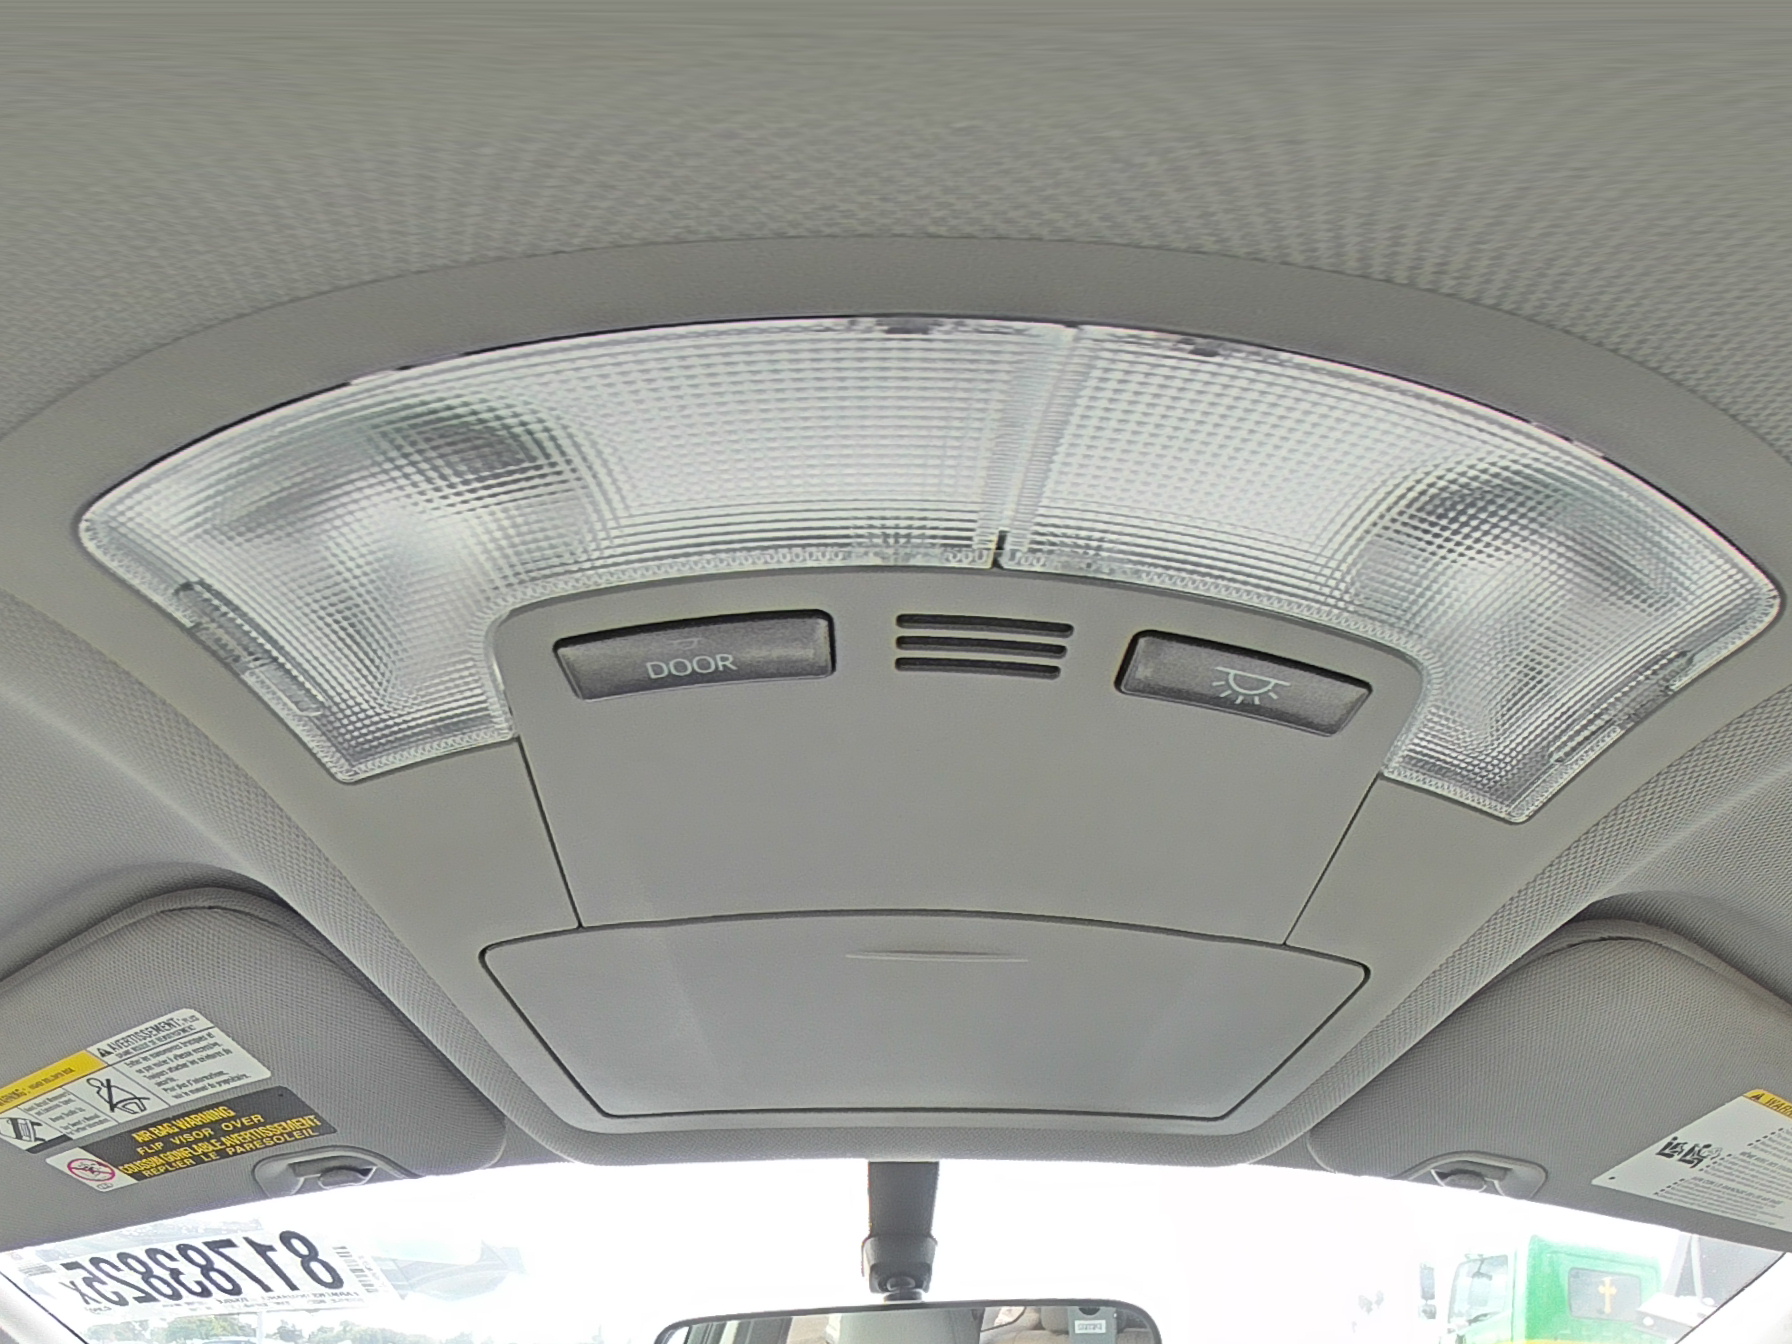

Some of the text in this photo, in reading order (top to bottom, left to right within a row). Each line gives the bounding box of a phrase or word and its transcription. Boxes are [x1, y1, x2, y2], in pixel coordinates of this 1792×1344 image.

[645, 652, 739, 680] DOOR
[117, 1114, 322, 1174] COUSSIN GONFLABLE AVERTISSEMENT
[131, 1105, 236, 1143] AIR BAG WARNING
[136, 1113, 265, 1156] FLIP VISOR OVER
[141, 1128, 320, 1178] REPLIER LE PARESOLEIL
